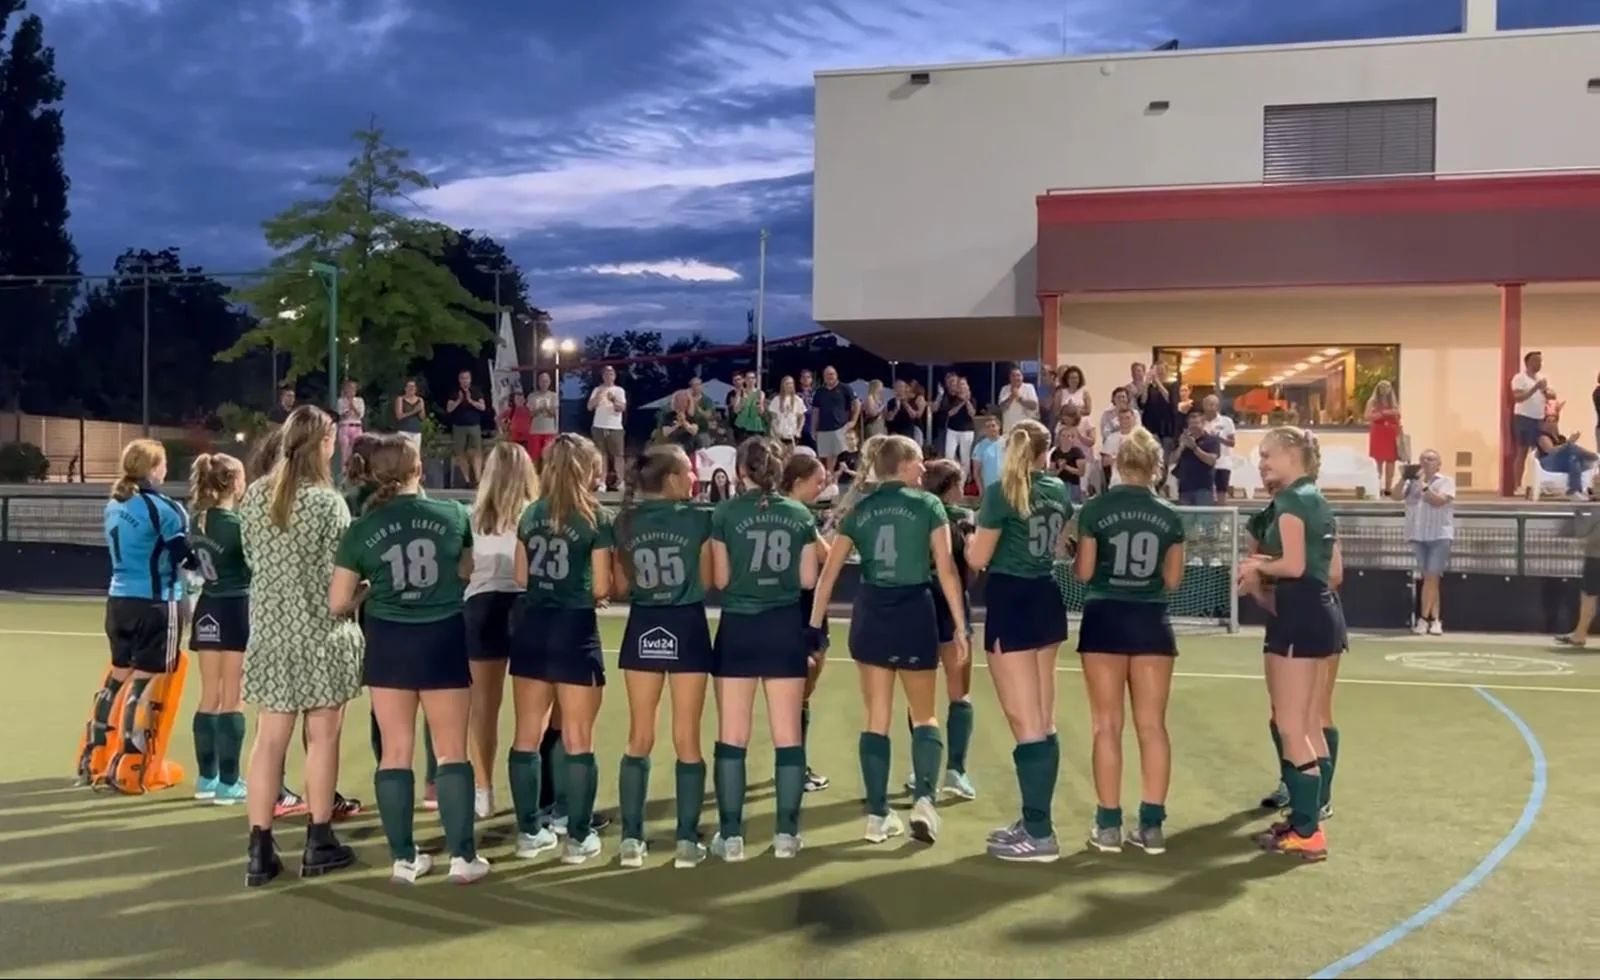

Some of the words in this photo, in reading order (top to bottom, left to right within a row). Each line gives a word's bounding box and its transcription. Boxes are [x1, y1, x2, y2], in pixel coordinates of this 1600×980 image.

[366, 527, 388, 548] CLUB
[1028, 513, 1064, 557] 58
[1098, 513, 1120, 529] CLUB
[1120, 511, 1171, 533] RAFFELBERG
[108, 526, 122, 563] 1
[379, 537, 439, 591] 18
[528, 534, 570, 580] 23
[746, 529, 792, 572] 78
[874, 524, 898, 567] 4
[1108, 531, 1160, 578] 19
[633, 546, 686, 589] 85
